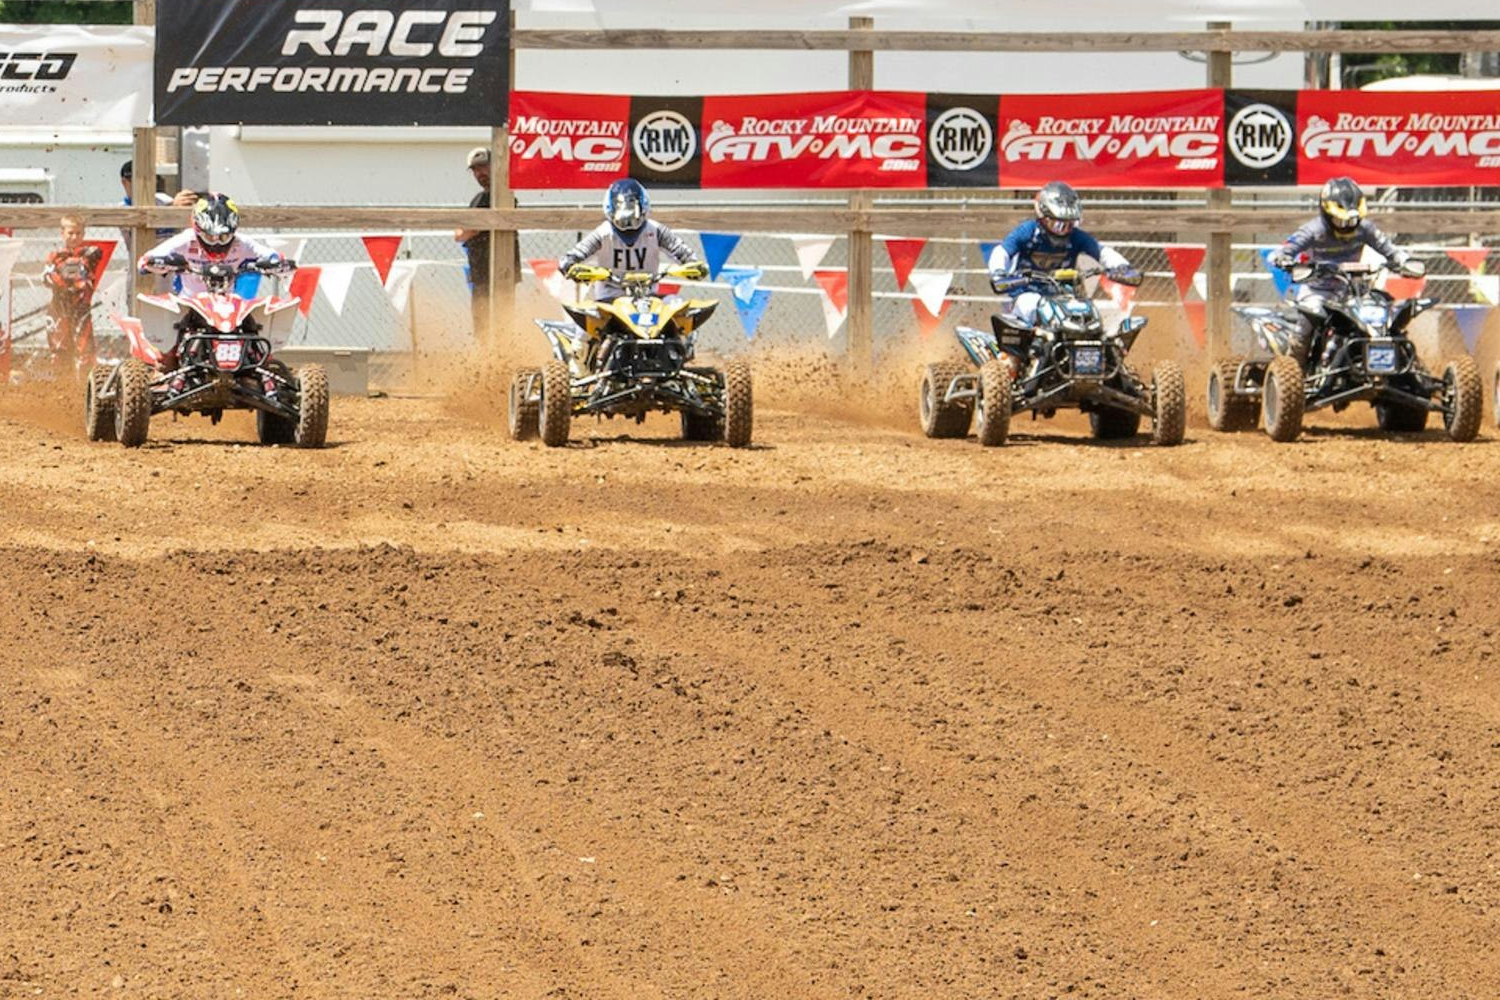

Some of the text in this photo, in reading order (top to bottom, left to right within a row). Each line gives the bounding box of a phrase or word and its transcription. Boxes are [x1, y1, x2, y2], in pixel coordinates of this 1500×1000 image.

[281, 10, 497, 57] RACE
[167, 67, 474, 93] PERFORMANCE
[512, 116, 623, 136] MOUNTAIN
[738, 115, 921, 134] ROCKY MOUNTAIN
[1036, 115, 1219, 134] ROCKY MOUNTAIN
[1334, 112, 1403, 131] ROCKY
[647, 127, 682, 153] RM
[943, 127, 978, 152] RM
[1242, 124, 1279, 148] RM
[613, 247, 647, 271] FLY
[216, 343, 241, 362] 88
